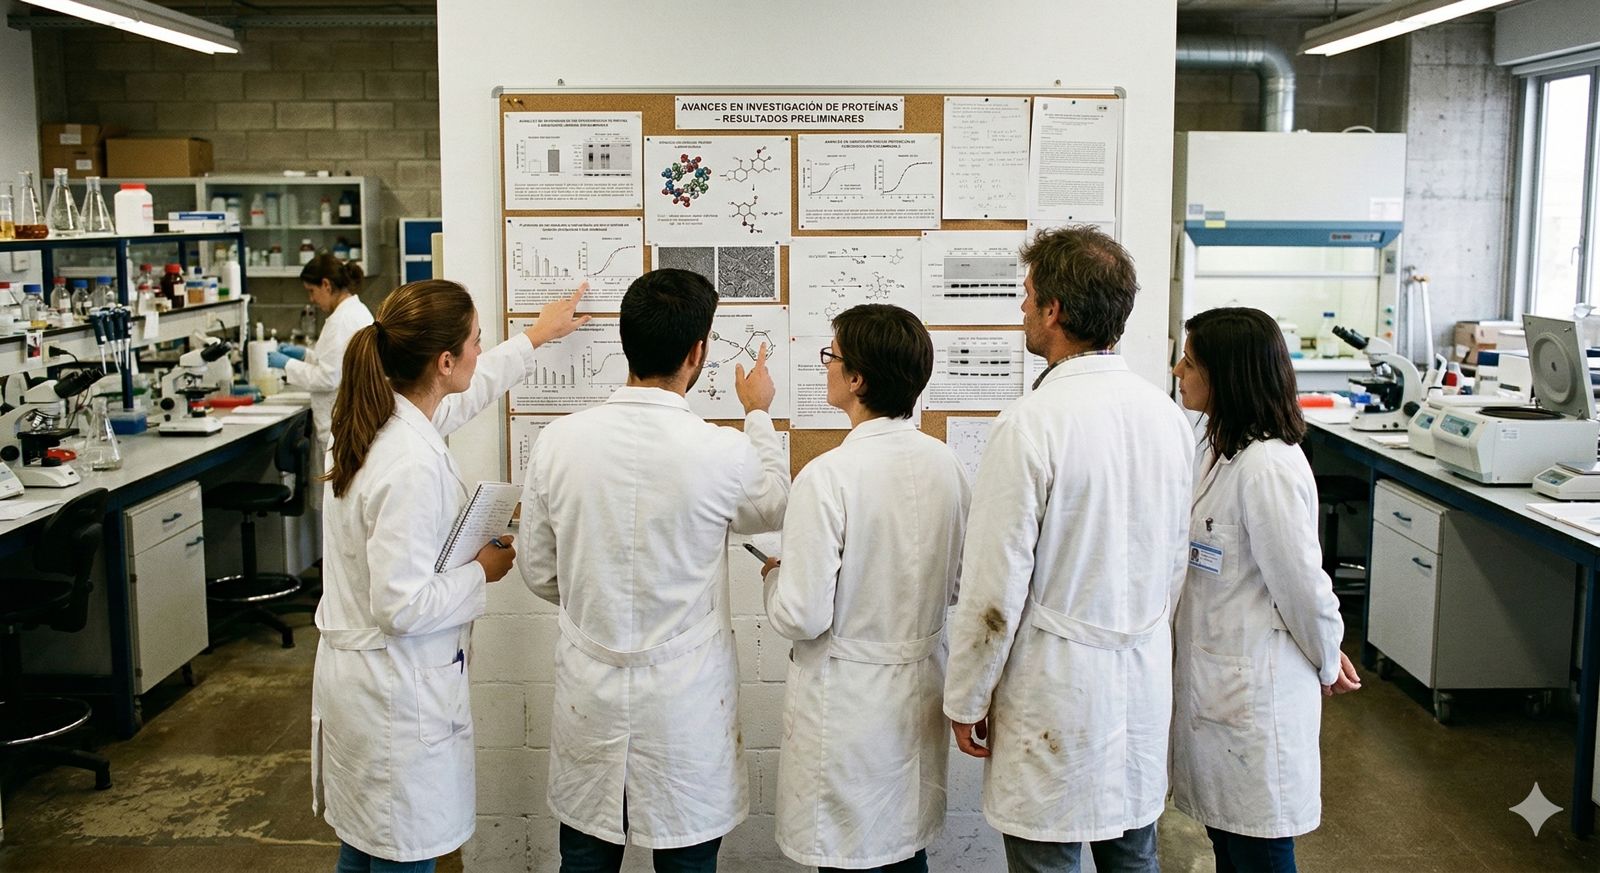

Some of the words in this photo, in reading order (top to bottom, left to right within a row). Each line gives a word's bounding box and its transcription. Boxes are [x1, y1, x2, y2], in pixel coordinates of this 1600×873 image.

[681, 102, 728, 112] AVANCES
[730, 102, 744, 112] EN
[746, 100, 823, 112] INVESTIGACIÓN
[826, 102, 839, 112] DE
[842, 100, 899, 112] PROTEÍNAS
[723, 114, 789, 123] RESULTADOS
[791, 114, 865, 123] PRELIMINARES
